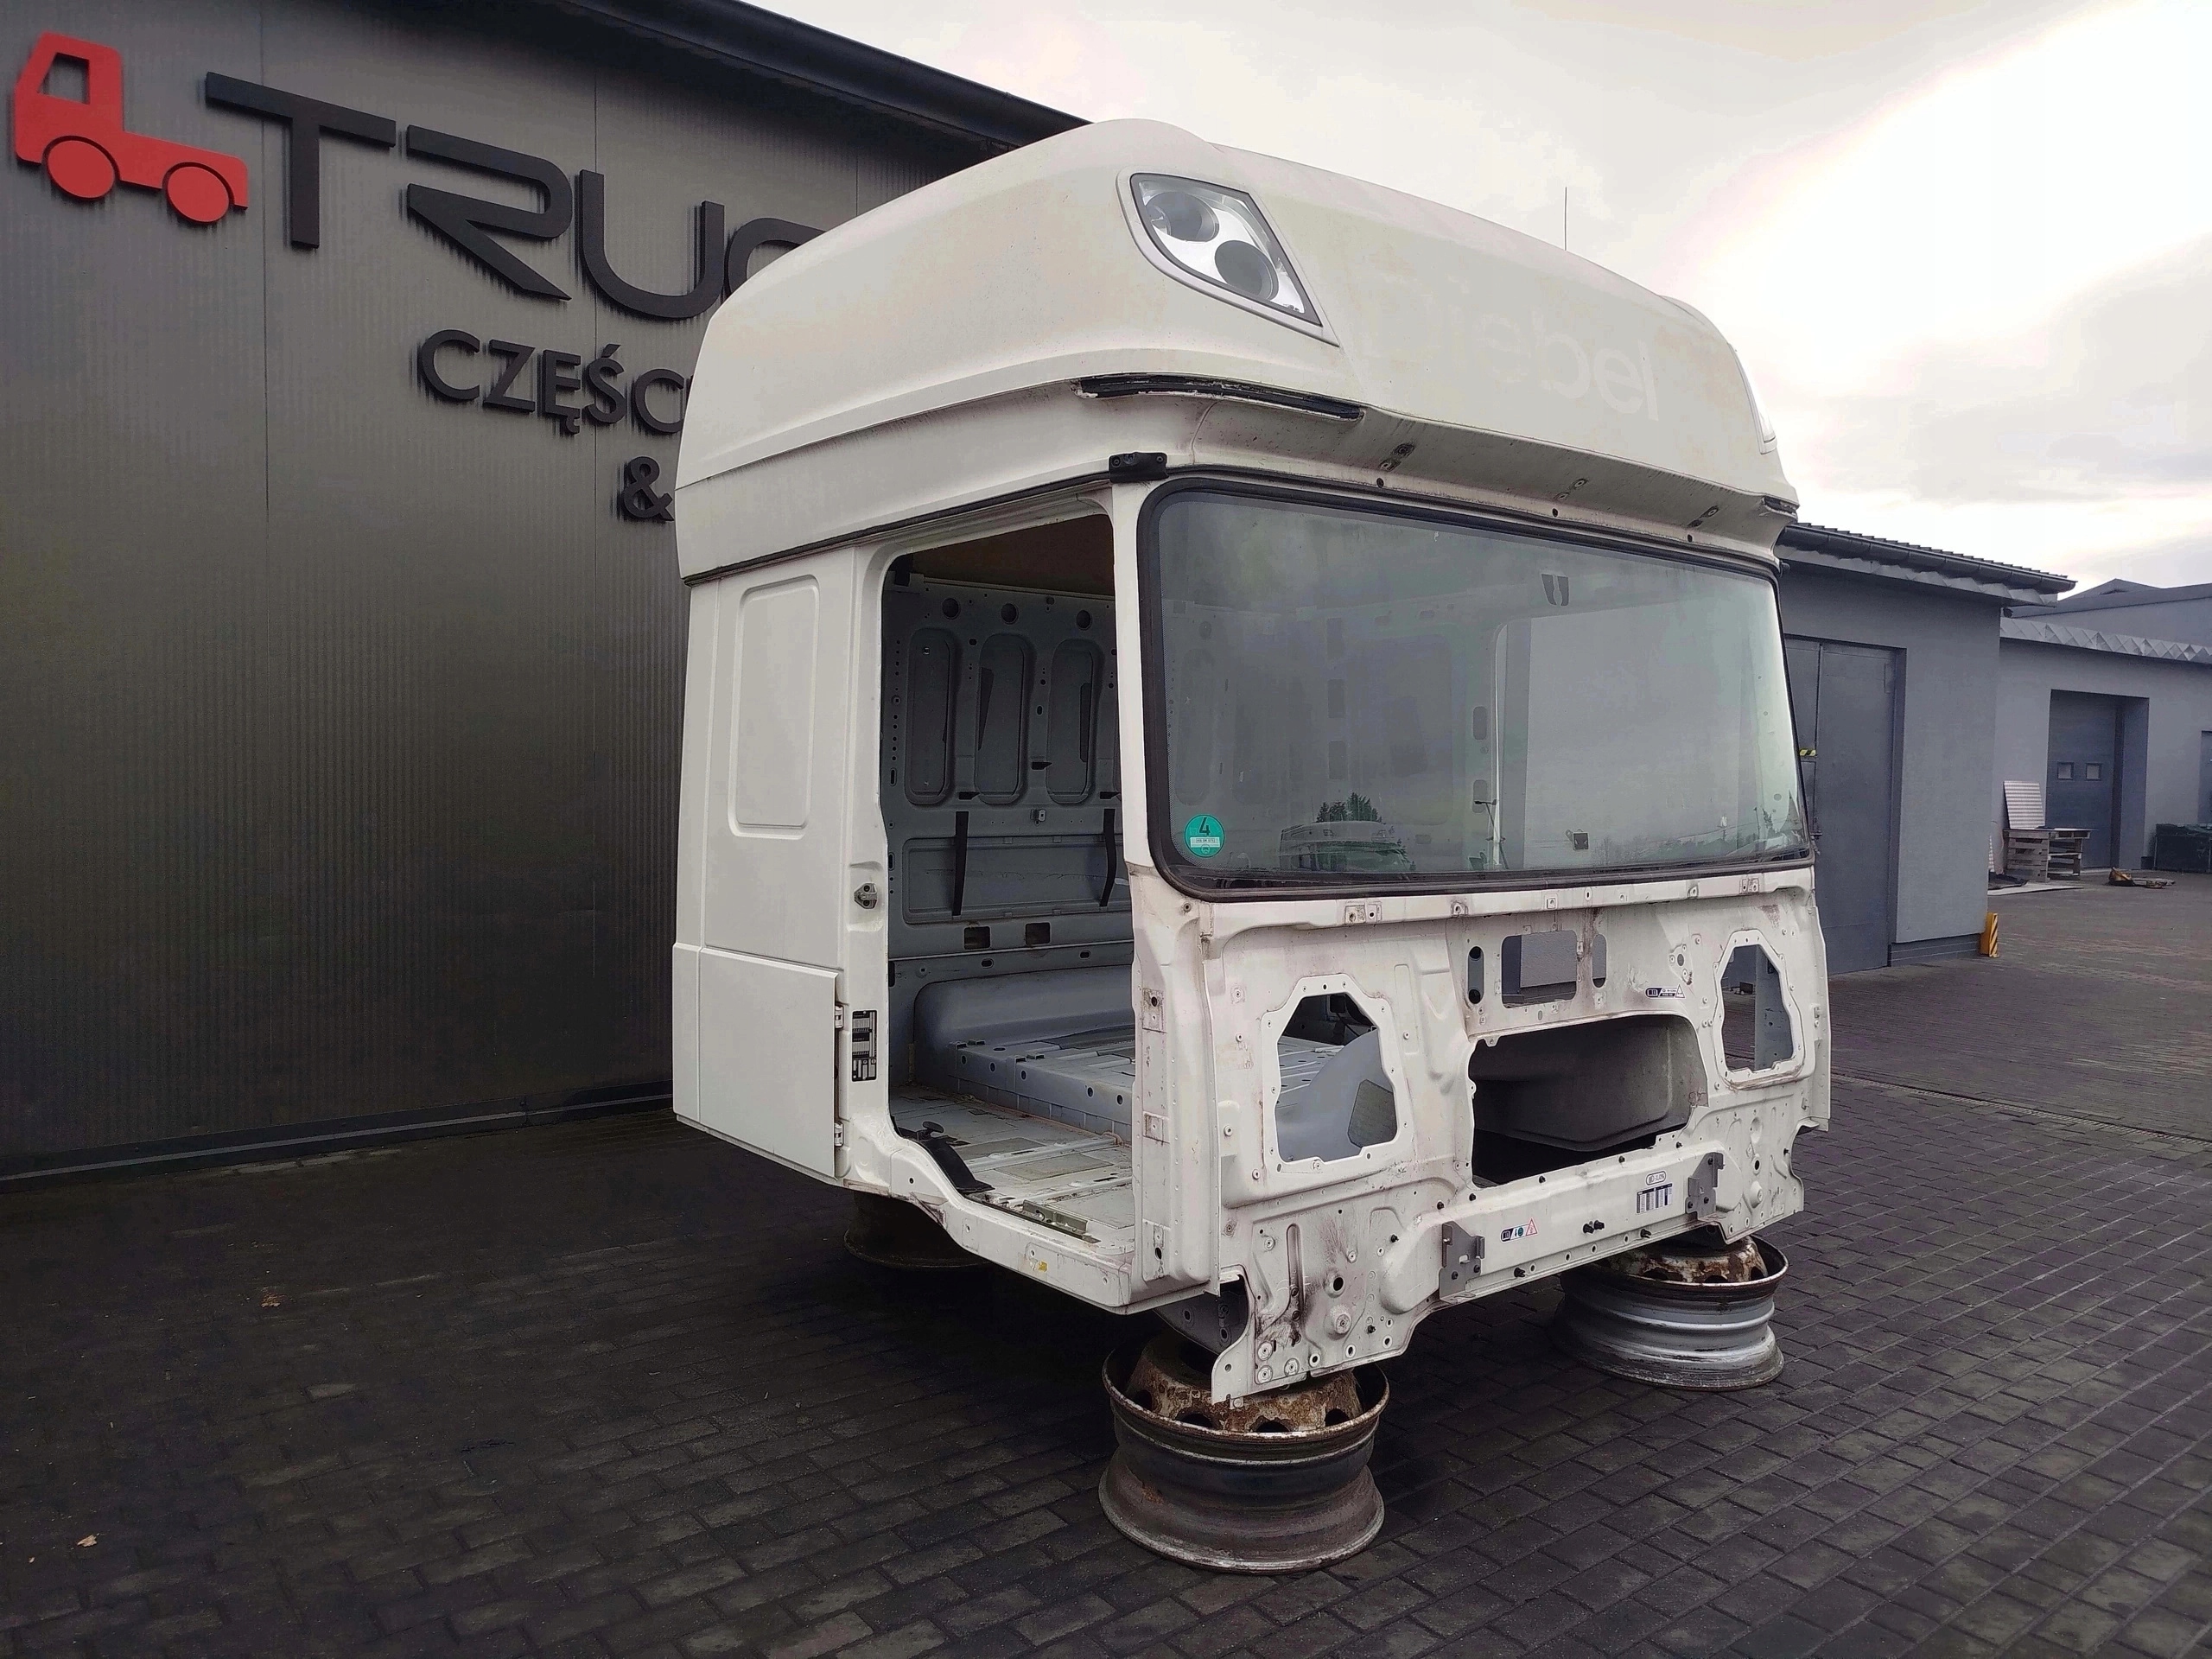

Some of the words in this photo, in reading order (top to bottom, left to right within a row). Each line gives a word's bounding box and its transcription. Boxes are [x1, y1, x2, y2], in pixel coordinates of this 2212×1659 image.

[417, 329, 695, 435] CZĘŚC
[622, 455, 675, 522] &
[1198, 817, 1211, 836] 4
